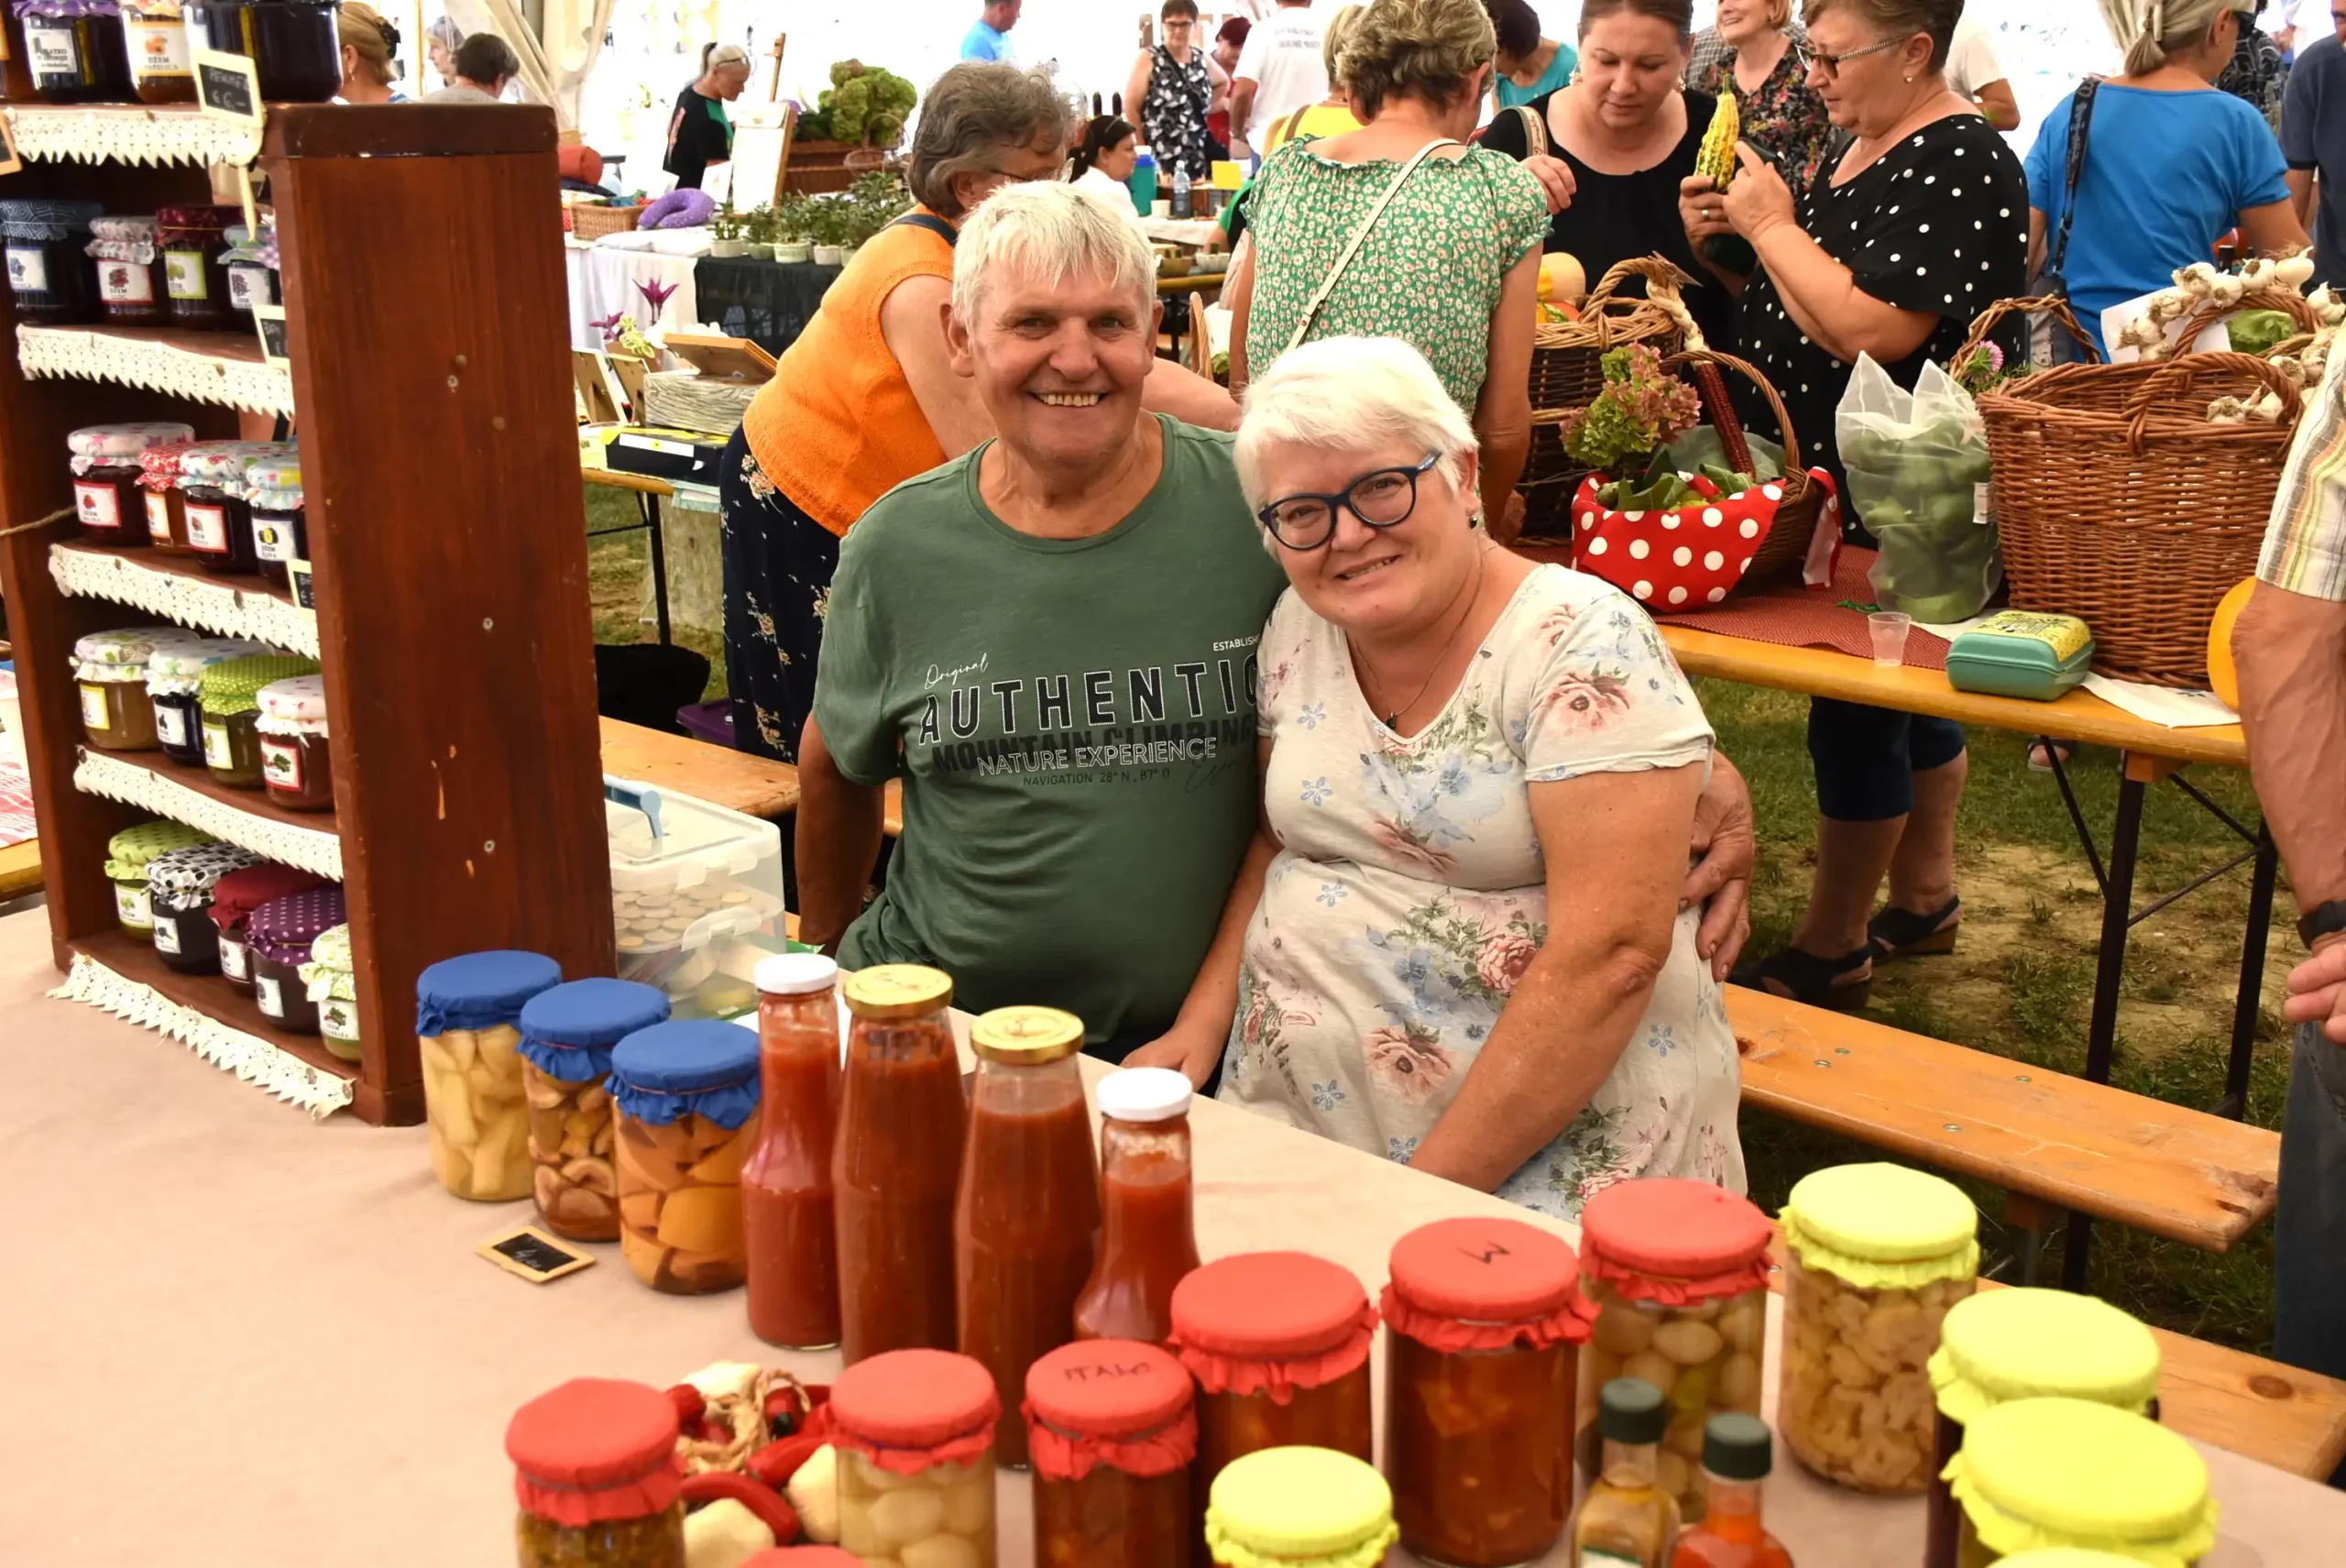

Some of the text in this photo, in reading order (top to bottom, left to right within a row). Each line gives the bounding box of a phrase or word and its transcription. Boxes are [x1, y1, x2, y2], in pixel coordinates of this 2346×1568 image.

[925, 652, 989, 689] Original
[919, 653, 1256, 746] AUTHENTIC
[932, 730, 1092, 773] MOUNTAIN
[977, 737, 1216, 776] NATURE EXPERIENCE
[1023, 773, 1092, 786] NAVIGATION
